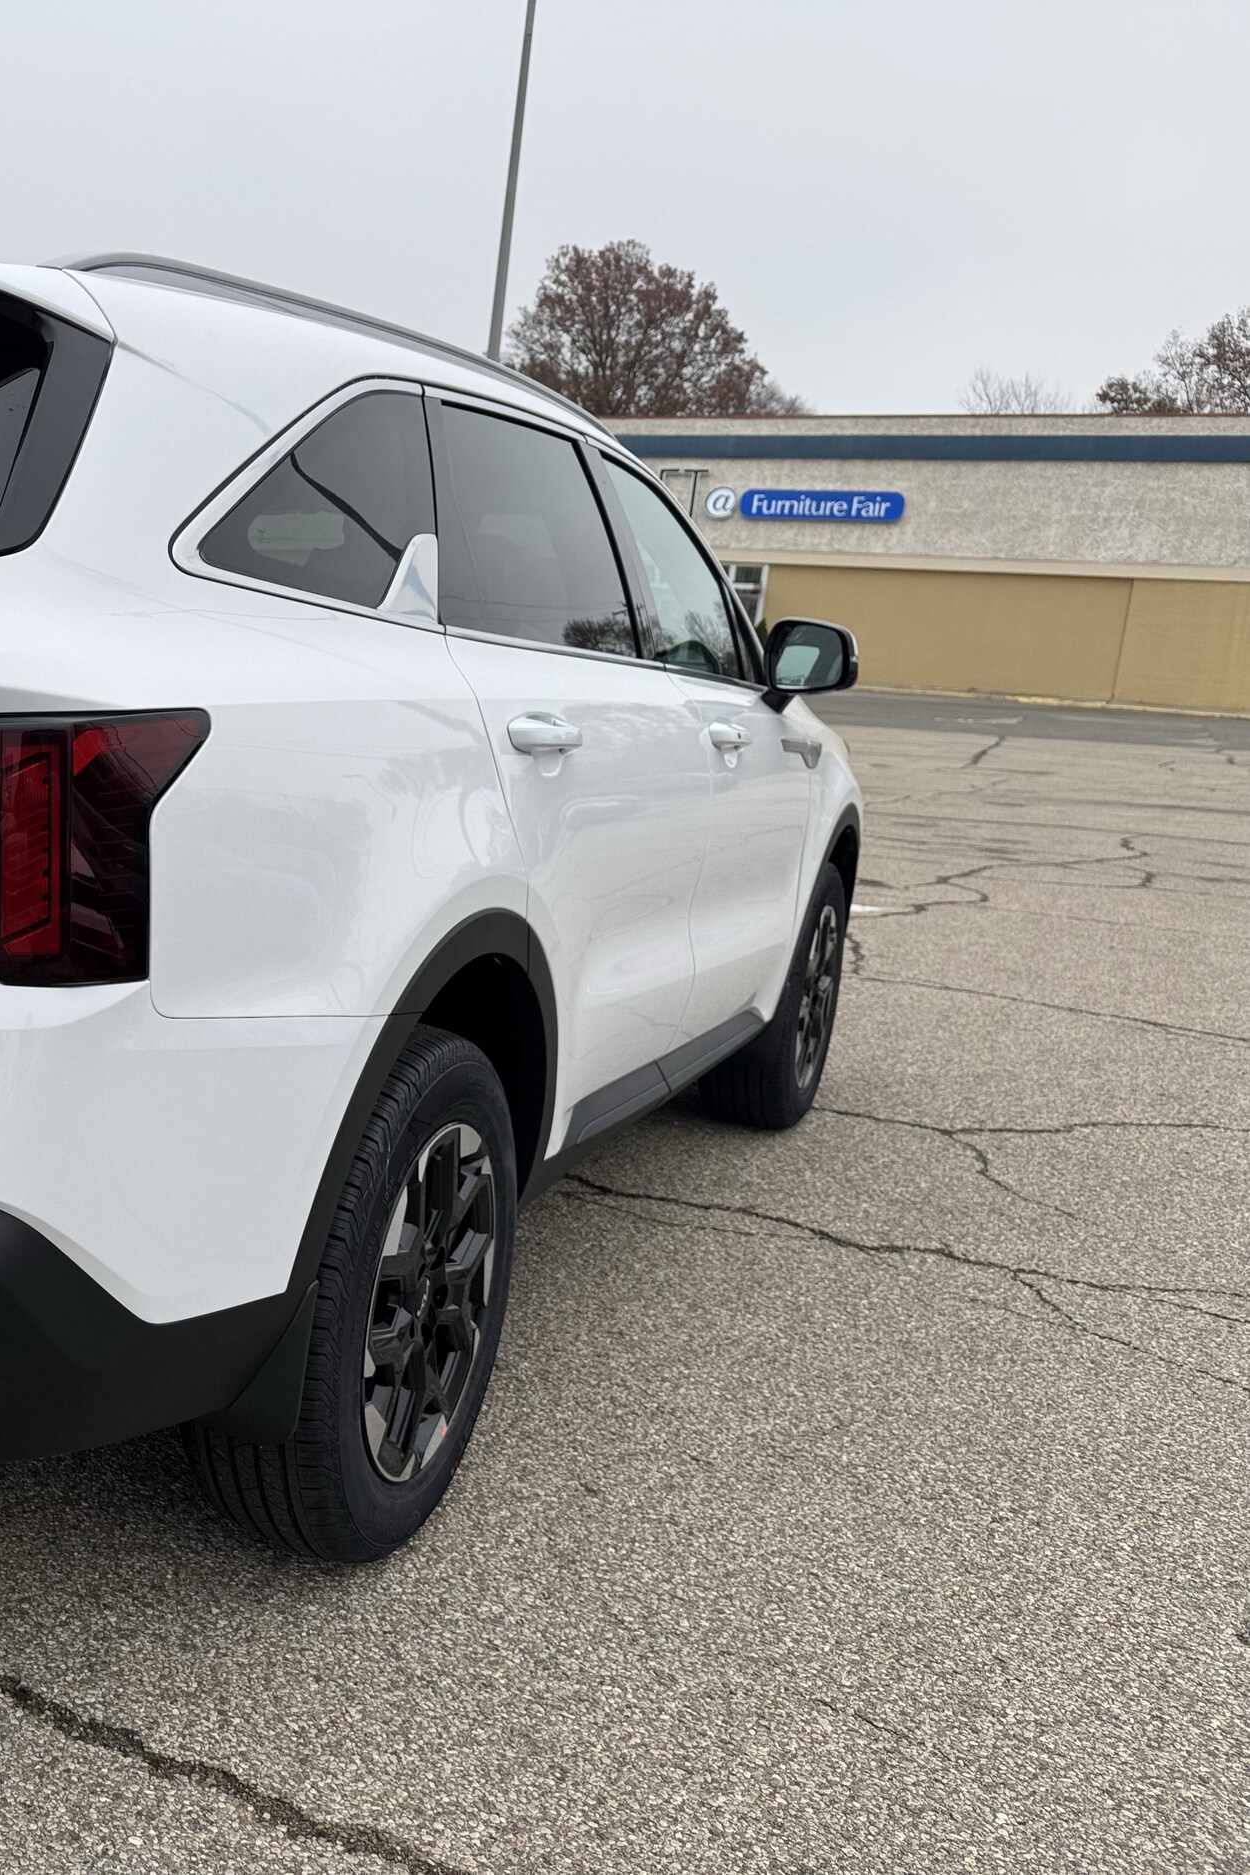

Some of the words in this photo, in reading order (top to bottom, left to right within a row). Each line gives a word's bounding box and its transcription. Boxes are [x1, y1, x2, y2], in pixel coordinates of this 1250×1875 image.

[705, 486, 737, 519] @
[751, 493, 848, 517] Furniture
[850, 495, 891, 518] Fair
